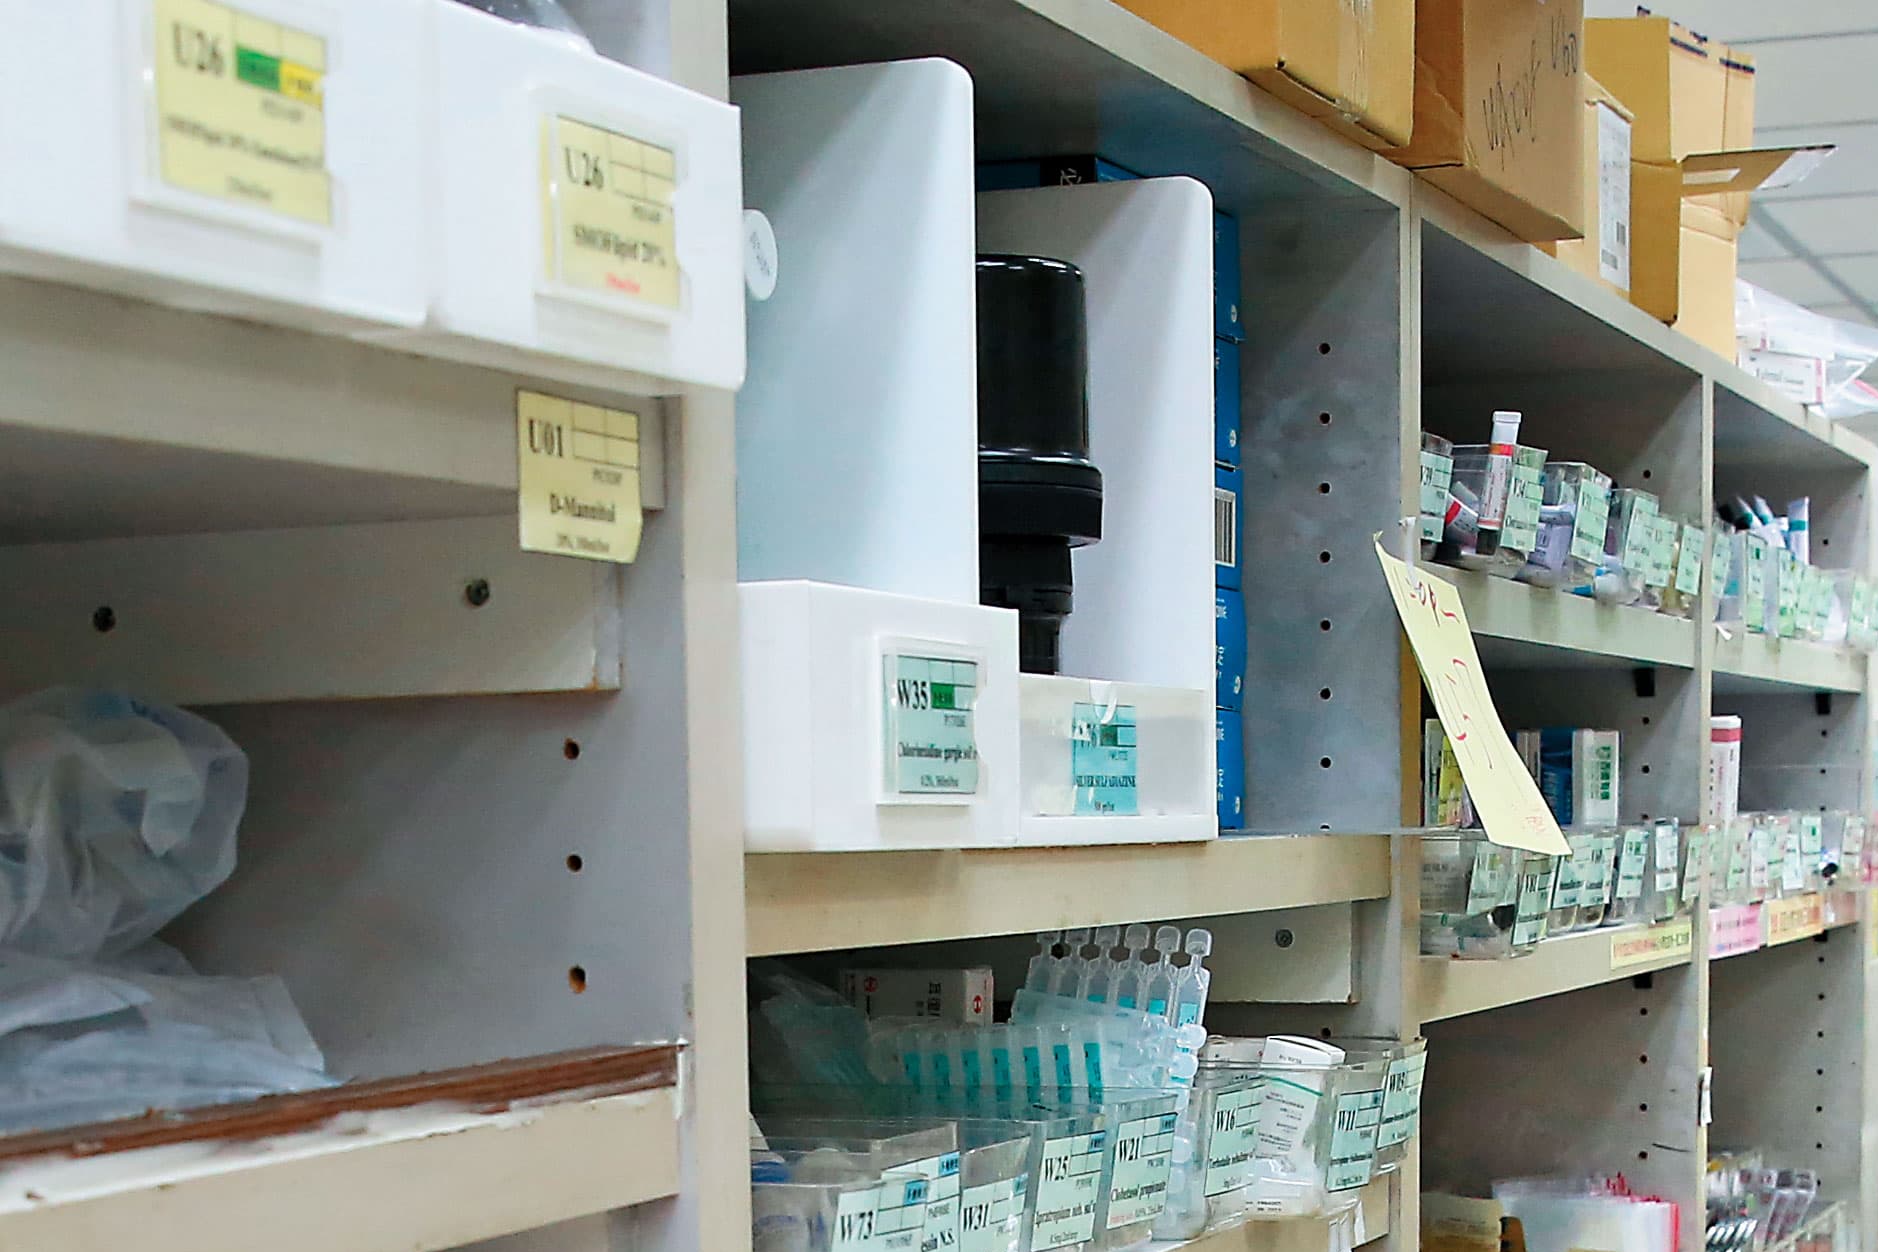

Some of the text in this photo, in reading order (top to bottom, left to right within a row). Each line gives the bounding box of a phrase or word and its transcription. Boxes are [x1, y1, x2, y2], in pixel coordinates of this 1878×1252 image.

[564, 146, 605, 190] U26
[528, 417, 564, 459] U01
[898, 679, 928, 710] W35
[1215, 1108, 1236, 1133] W16
[1119, 1136, 1140, 1163] W21
[1045, 1155, 1069, 1182] W25
[840, 1210, 875, 1243] W73
[963, 1202, 990, 1232] W31
